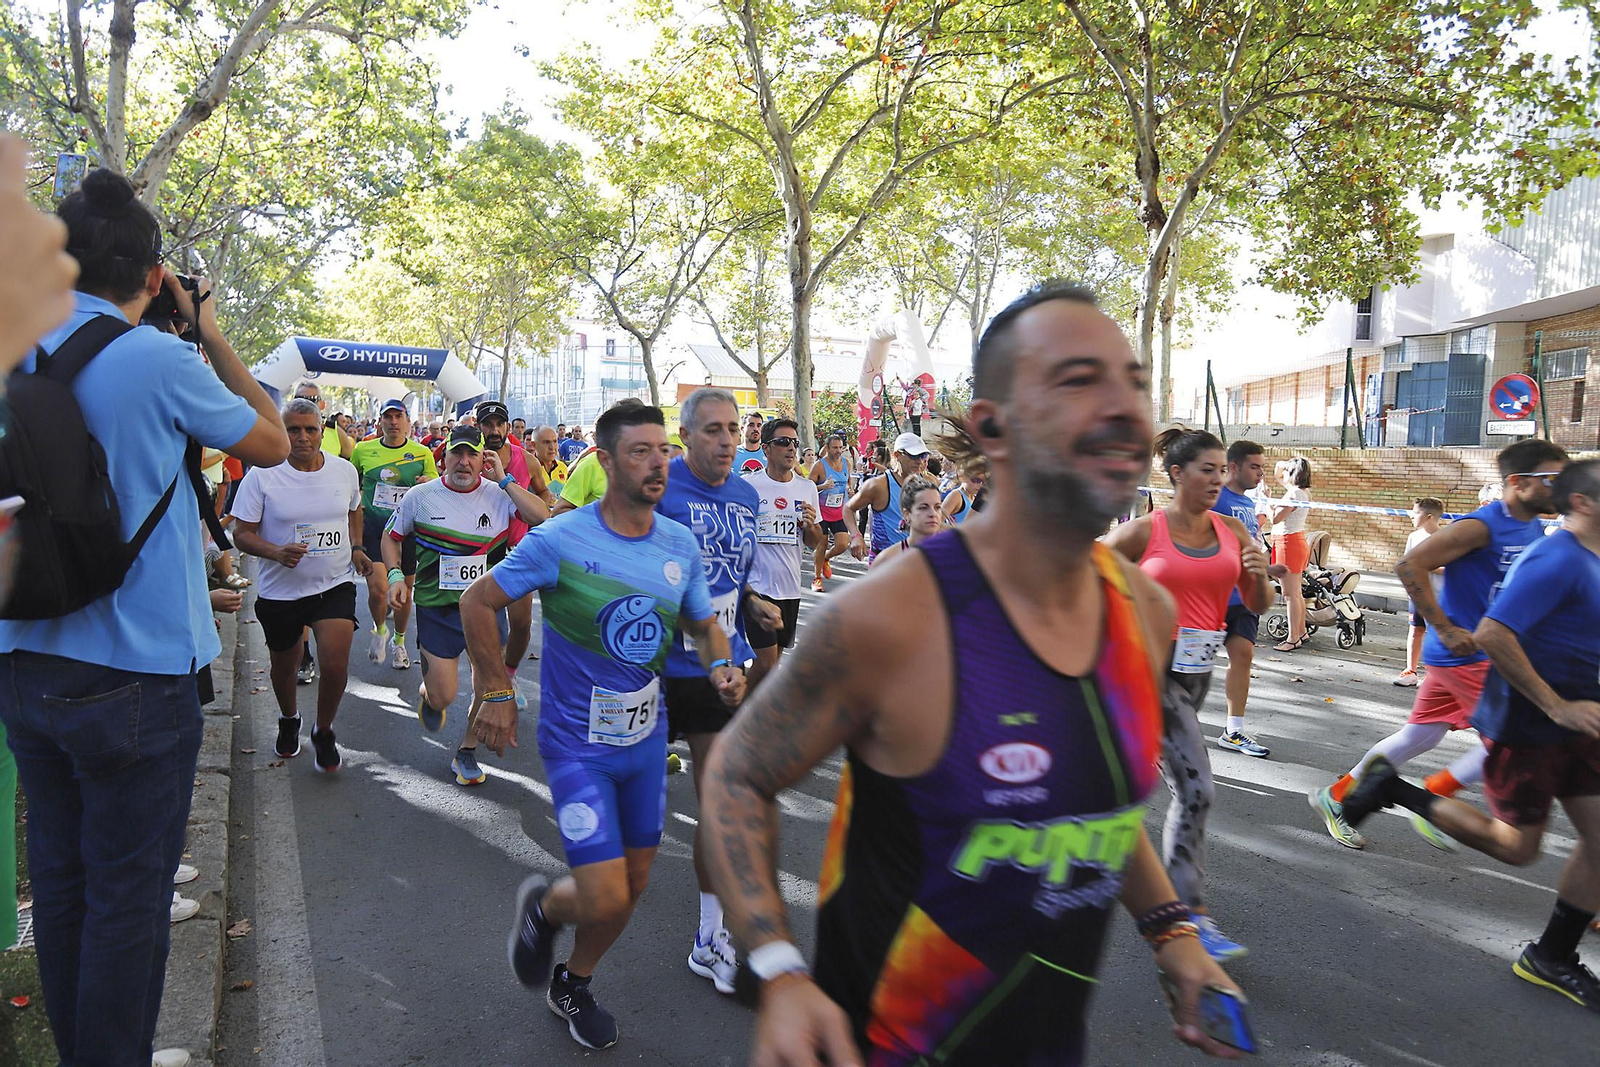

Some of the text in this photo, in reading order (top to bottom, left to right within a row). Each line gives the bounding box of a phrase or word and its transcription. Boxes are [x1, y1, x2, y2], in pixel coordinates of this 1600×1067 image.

[353, 349, 428, 366] HYUNDAI
[387, 366, 427, 377] SYRLUZ
[772, 520, 796, 535] 112
[316, 530, 341, 548] 730
[460, 563, 484, 580] 661
[629, 621, 657, 643] JD
